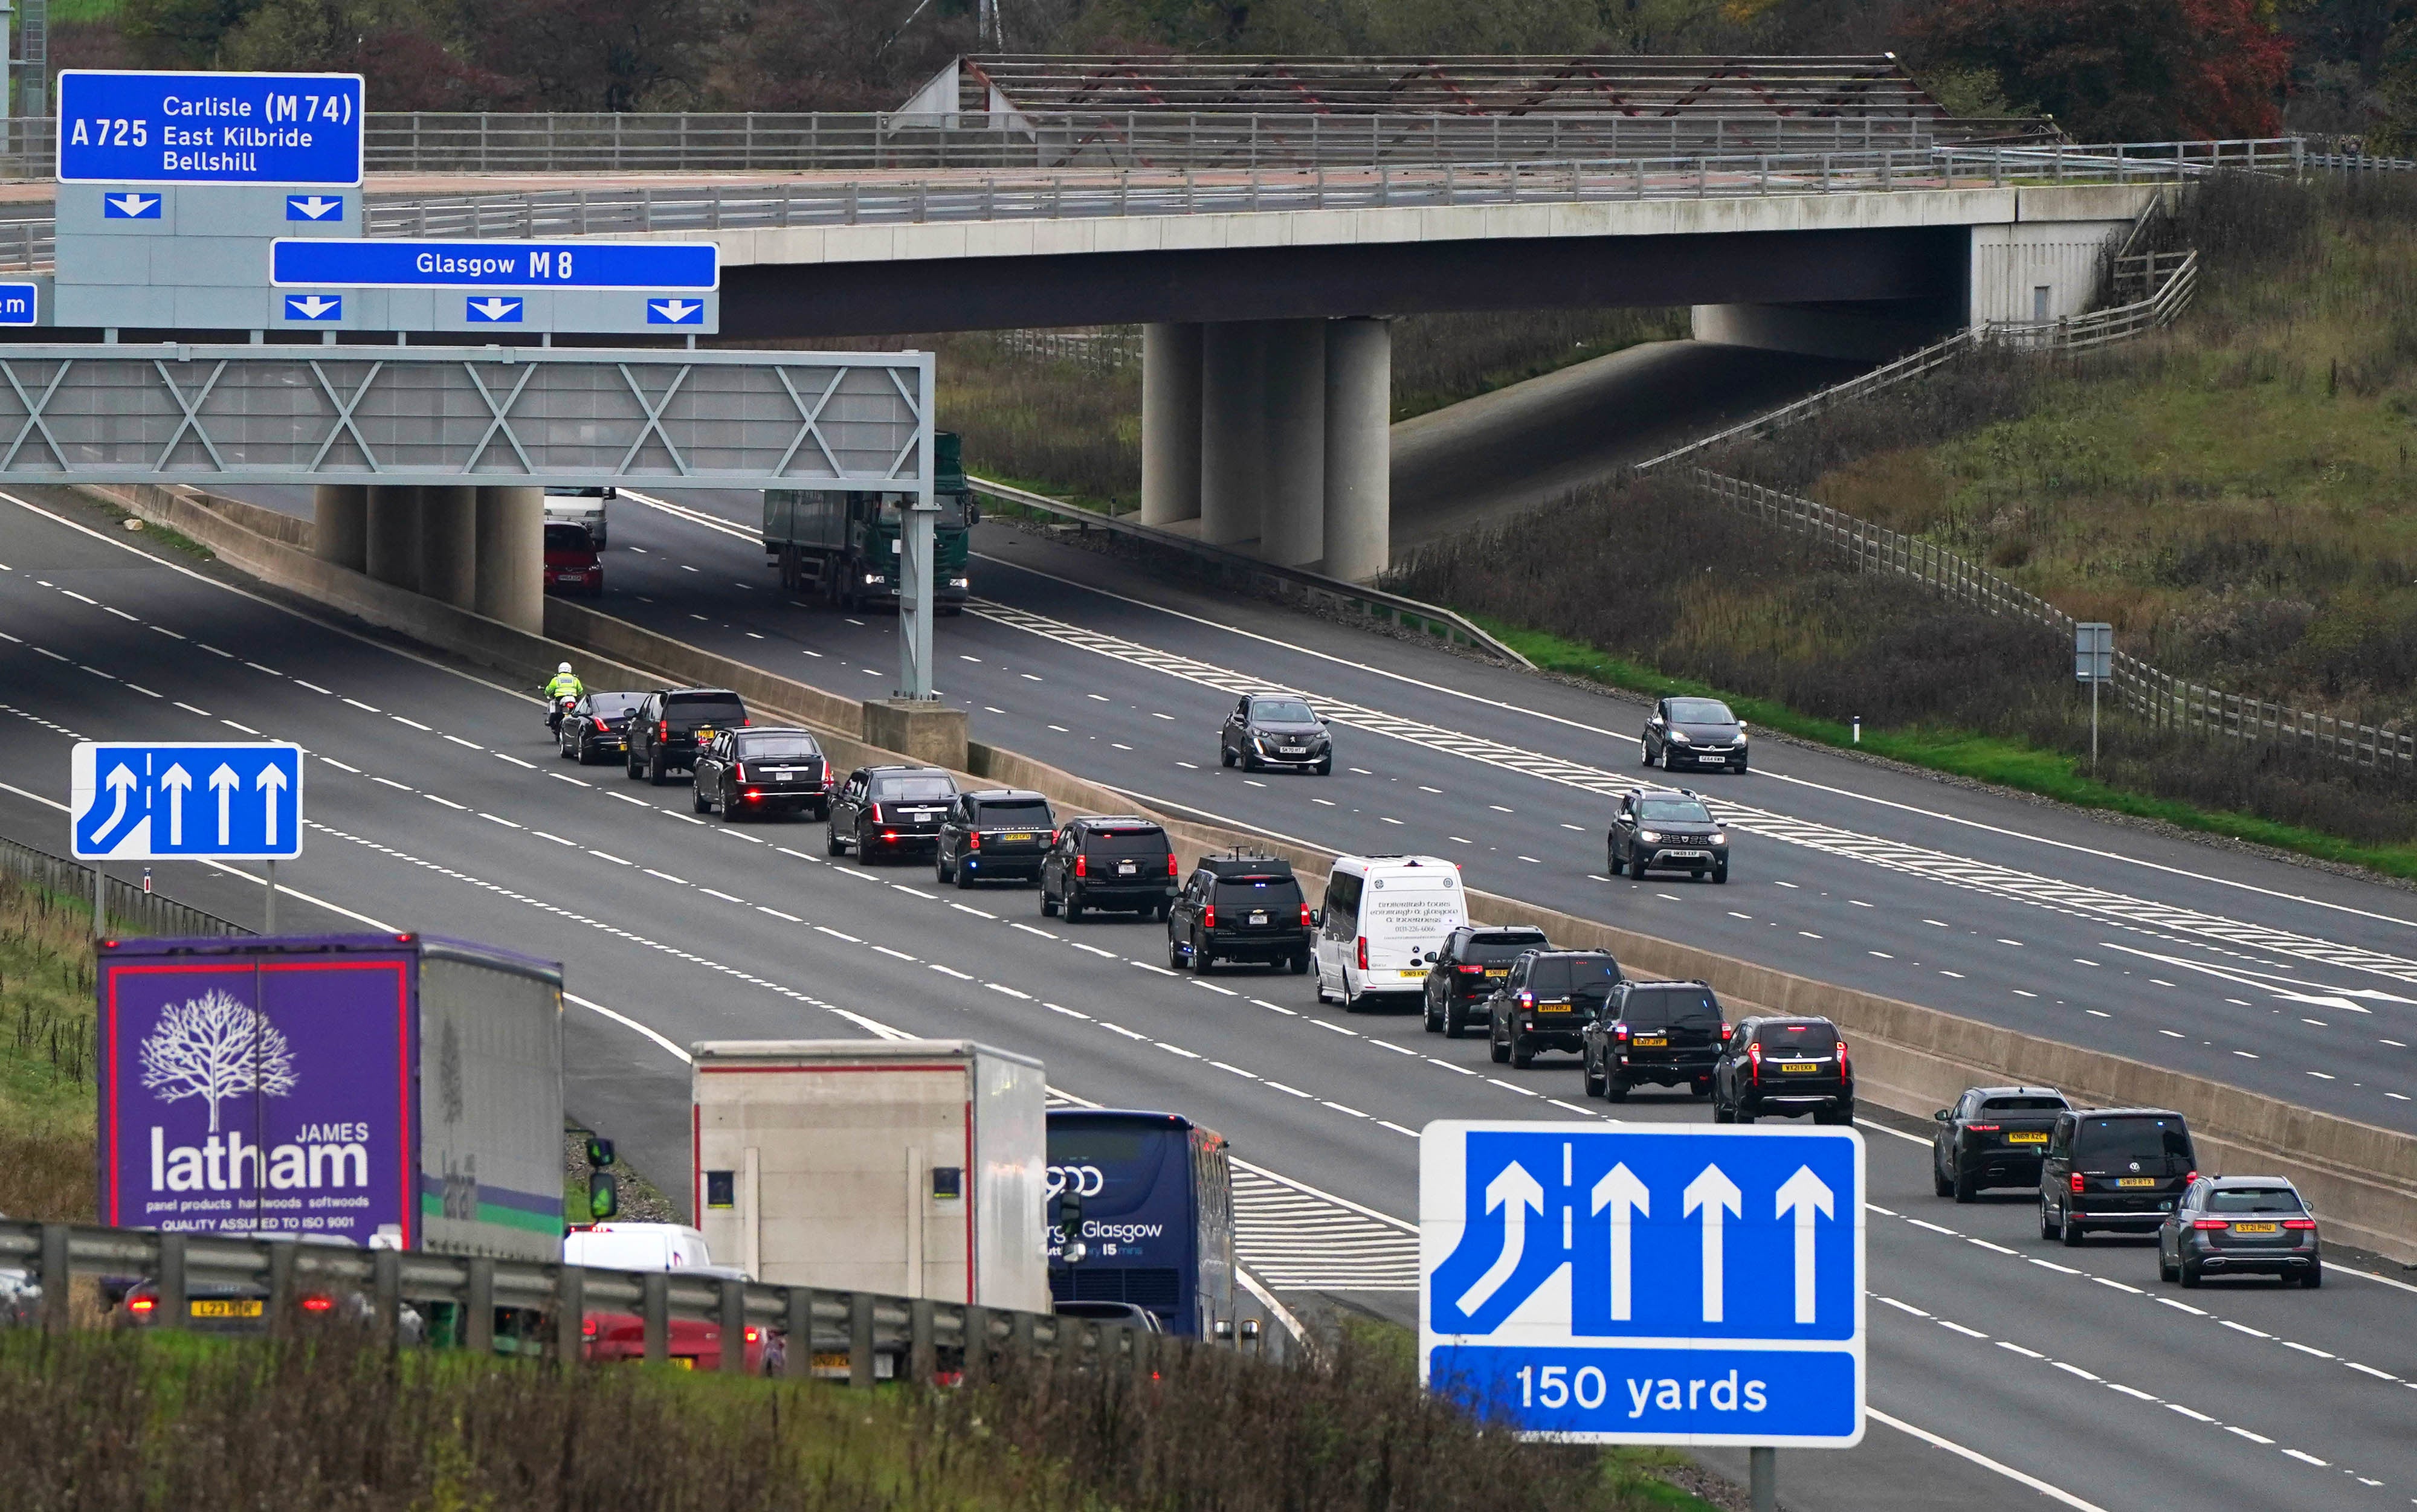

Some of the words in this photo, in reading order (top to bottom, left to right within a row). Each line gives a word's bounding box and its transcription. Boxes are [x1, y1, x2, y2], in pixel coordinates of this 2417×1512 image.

[163, 96, 251, 117] Carlisle
[164, 126, 213, 146] East
[224, 127, 312, 147] Kilbride
[164, 151, 257, 172] Bellshill
[416, 253, 515, 277] Glasgow
[295, 1122, 369, 1143] JAMES
[151, 1126, 368, 1191] latham
[146, 1198, 177, 1213] panel
[181, 1198, 231, 1212] products
[239, 1197, 302, 1209] harwoods
[308, 1196, 369, 1208] softwoods
[162, 1219, 216, 1232] QUALITY
[282, 1217, 299, 1229] TO
[302, 1216, 324, 1229] ISO
[327, 1216, 355, 1228] 9001
[1082, 1220, 1163, 1243] Glasgow
[1103, 1243, 1117, 1256] 15
[1517, 1366, 1606, 1409] 150
[1627, 1369, 1767, 1418] yards
